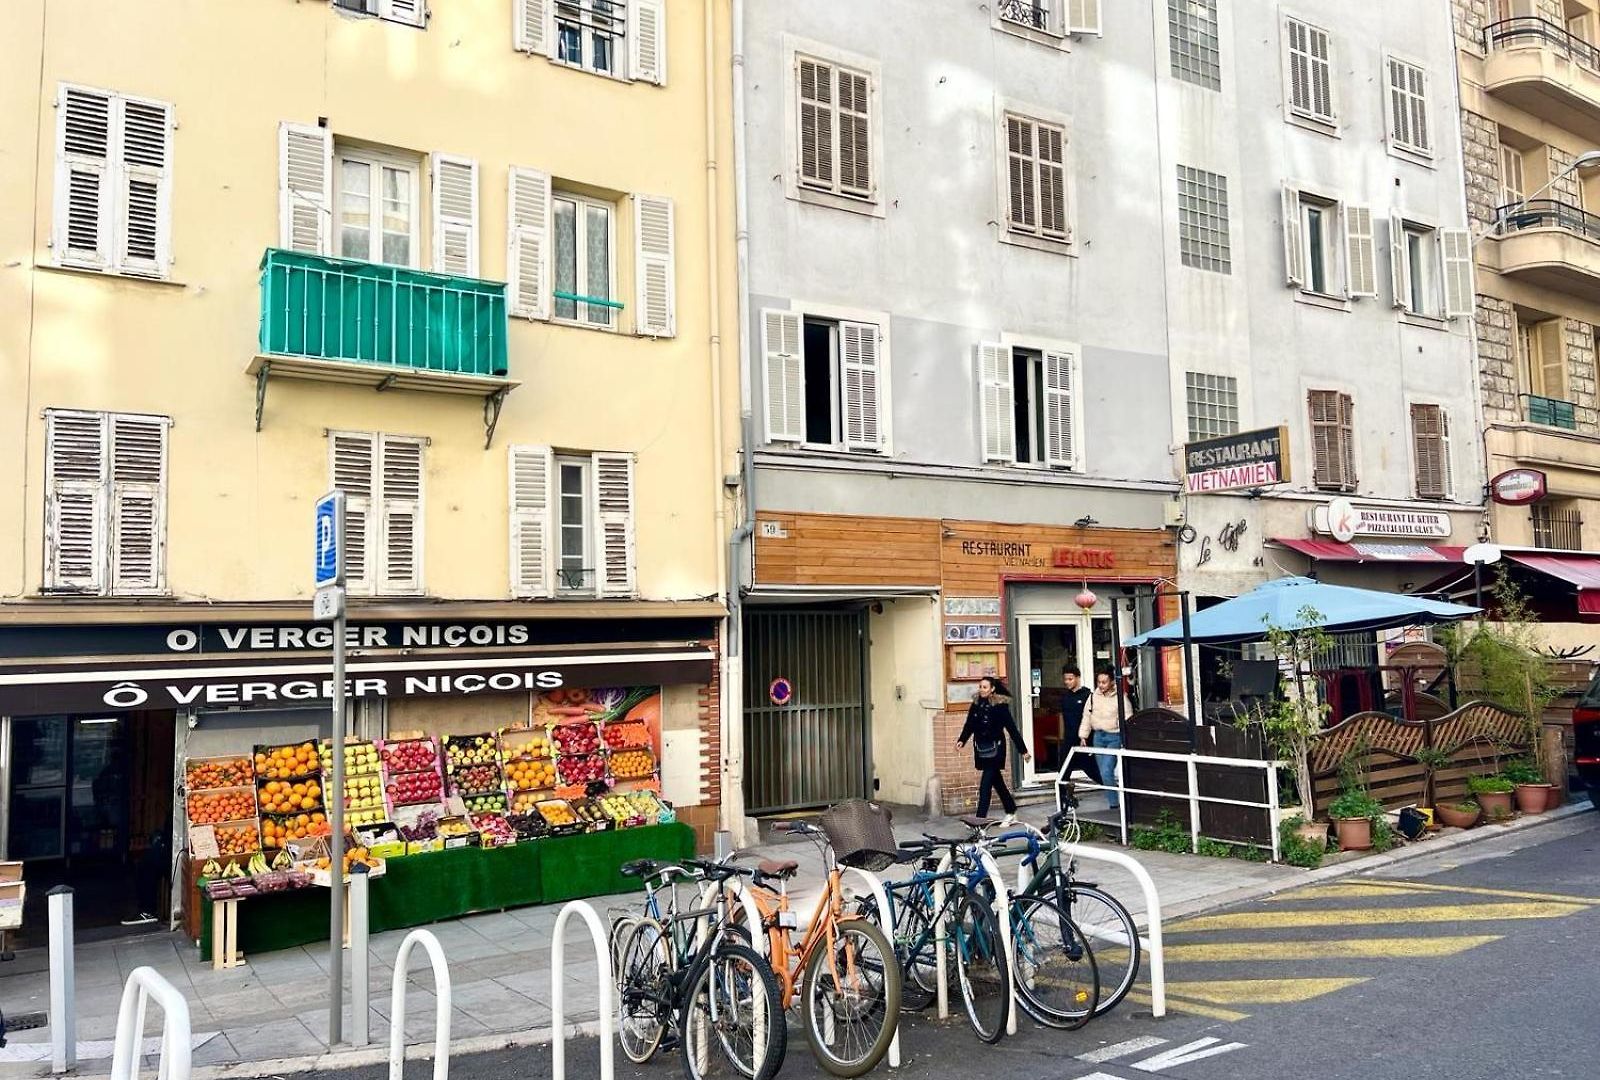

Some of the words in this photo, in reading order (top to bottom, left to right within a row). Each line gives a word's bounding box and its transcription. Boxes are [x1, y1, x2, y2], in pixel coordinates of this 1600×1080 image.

[1189, 437, 1280, 467] RESTAURANT
[1187, 463, 1277, 491] VIETNAMIEN
[1360, 511, 1406, 523] RESTAURANT
[1407, 514, 1416, 524] LE
[962, 541, 1032, 557] RESTAURANT
[1071, 547, 1115, 569] LOTUS
[166, 629, 198, 651] O
[218, 626, 389, 649] VERGER
[402, 624, 530, 648] NIÇOIS
[102, 681, 149, 708] Ô
[165, 678, 388, 705] VERGER
[404, 671, 564, 694] NIÇOIS
